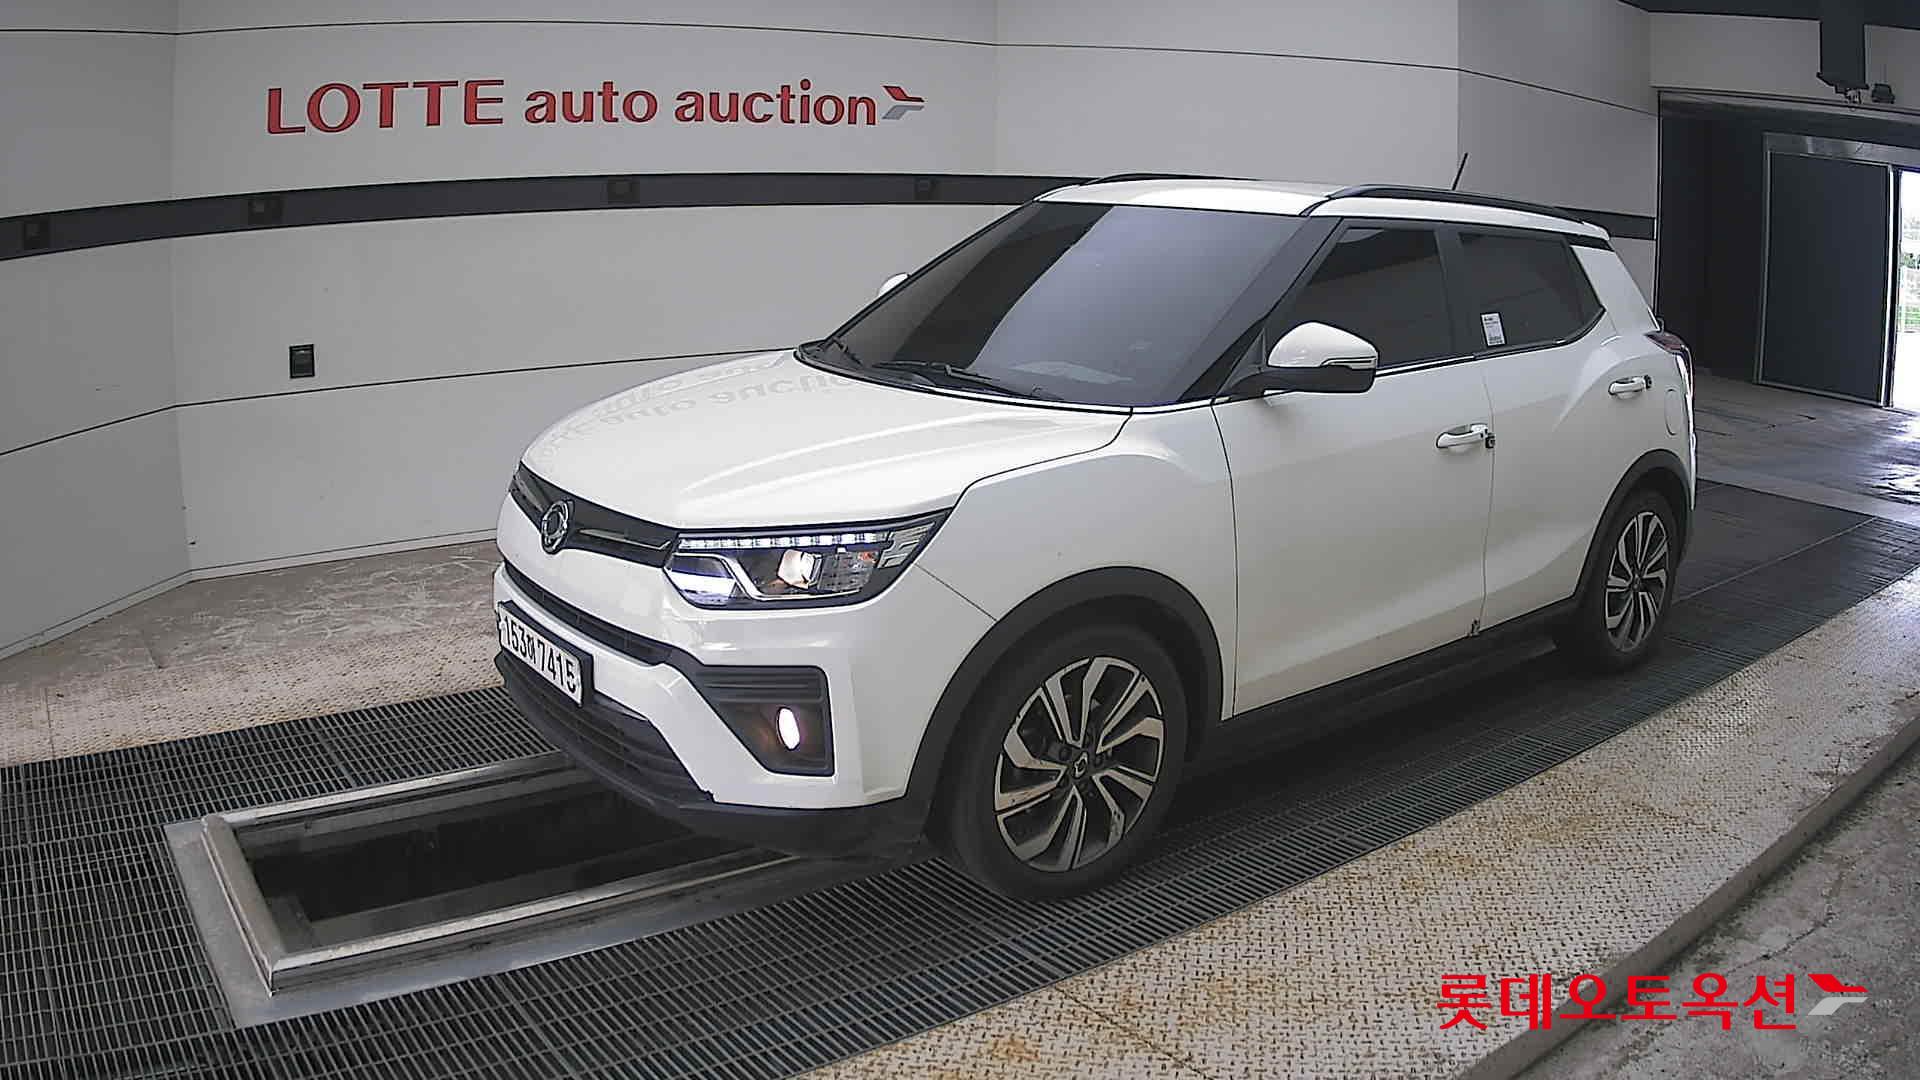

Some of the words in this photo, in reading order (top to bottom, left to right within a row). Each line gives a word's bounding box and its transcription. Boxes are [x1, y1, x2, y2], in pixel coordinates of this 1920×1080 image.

[268, 80, 504, 134] LOTTE
[525, 81, 658, 124] auto
[674, 79, 876, 126] auction
